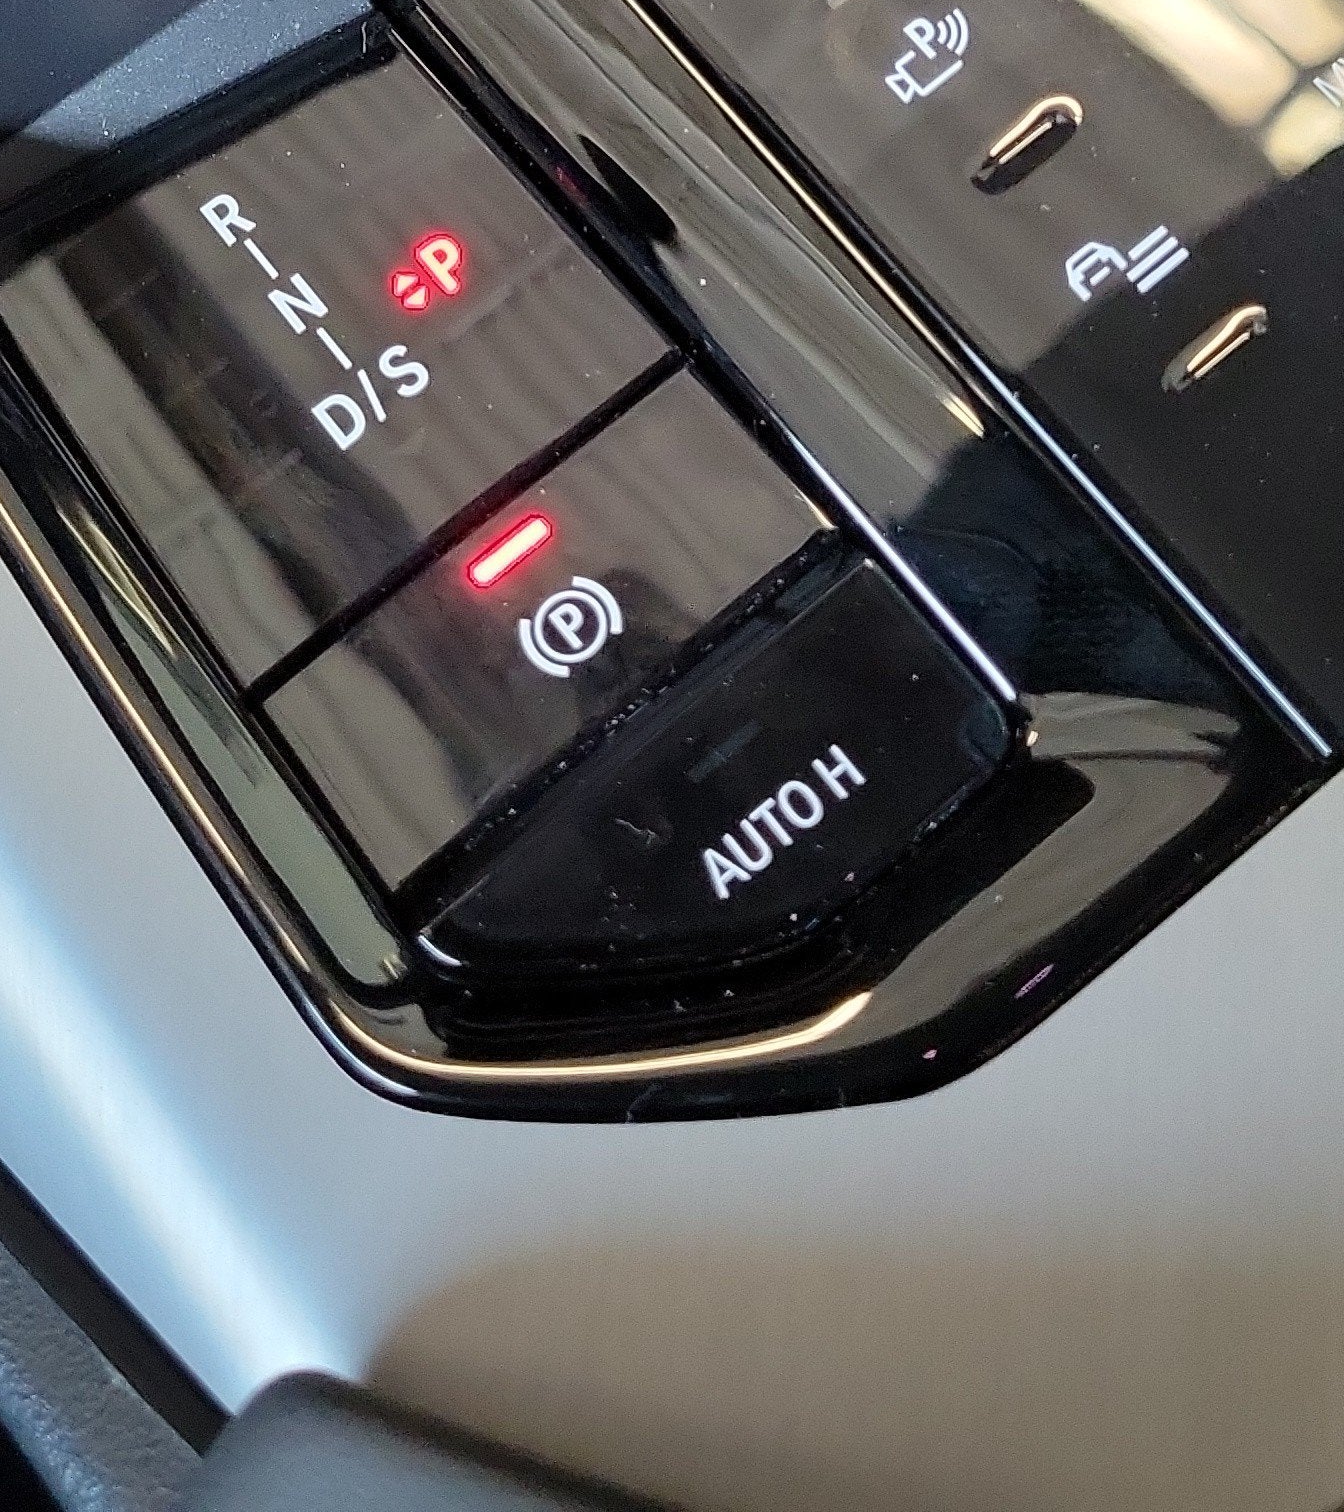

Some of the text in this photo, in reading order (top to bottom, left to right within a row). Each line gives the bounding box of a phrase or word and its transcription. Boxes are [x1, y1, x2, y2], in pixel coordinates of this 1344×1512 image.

[200, 193, 256, 247] R
[416, 234, 463, 296] P
[267, 272, 330, 334] N
[311, 344, 430, 451] D/S
[700, 743, 868, 899] AUTO H
